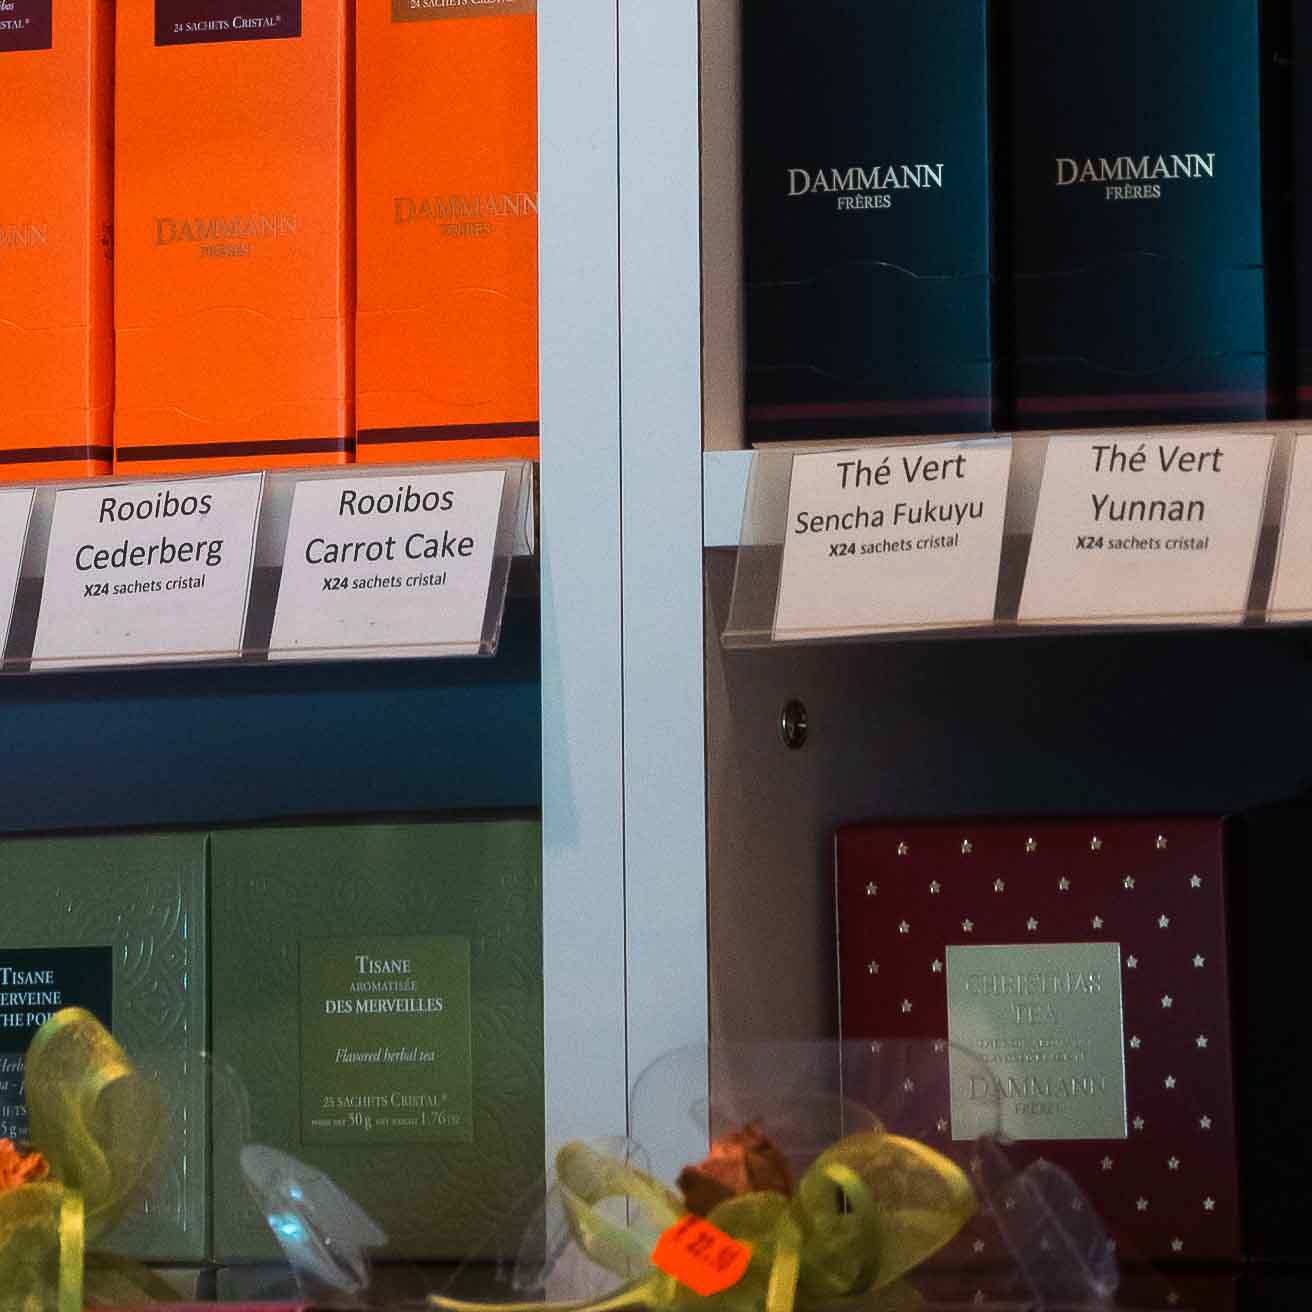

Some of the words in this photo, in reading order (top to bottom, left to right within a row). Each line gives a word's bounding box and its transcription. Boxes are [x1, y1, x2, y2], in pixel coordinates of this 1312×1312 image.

[788, 164, 944, 196] DAMMANN
[837, 458, 890, 489] Thé
[902, 453, 967, 482] Vert
[1091, 443, 1145, 473] Thé
[1154, 445, 1223, 473] Vert
[99, 490, 212, 523] Rooibos
[338, 486, 454, 516] Rooibos
[1091, 494, 1206, 522] Yunnan
[795, 507, 884, 536] Sencha
[892, 500, 984, 530] Fukuyu
[75, 536, 224, 571] Cederberg
[305, 535, 395, 564] Carrot
[404, 530, 475, 559] Cake
[1076, 536, 1103, 551] X24
[1107, 536, 1161, 551] sachets
[1165, 536, 1209, 552] cristal
[323, 577, 348, 591] X24
[351, 575, 402, 590] sachets
[404, 572, 447, 588] cristal
[0, 968, 54, 987] TISANE
[355, 955, 410, 974] TISANE
[325, 999, 352, 1014] DES
[356, 997, 443, 1013] MERVEILLES
